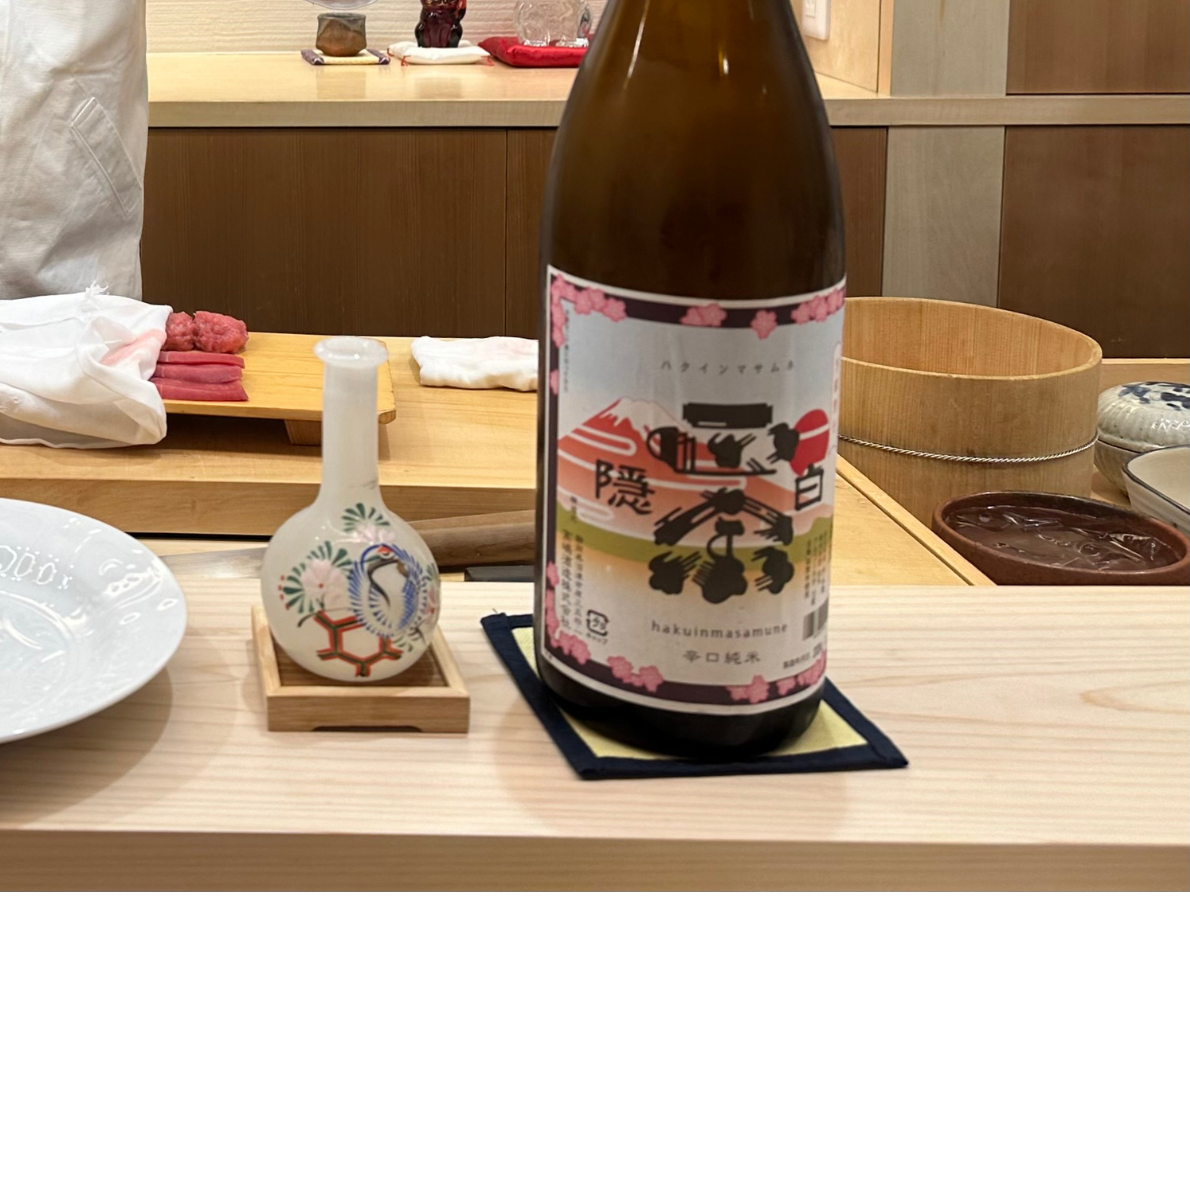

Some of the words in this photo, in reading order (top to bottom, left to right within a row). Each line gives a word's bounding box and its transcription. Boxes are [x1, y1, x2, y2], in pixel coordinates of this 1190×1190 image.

[594, 458, 656, 516] 隠
[794, 462, 825, 511] 白
[651, 619, 789, 639] hakuinmasamune
[682, 649, 761, 665] 辛口純米
